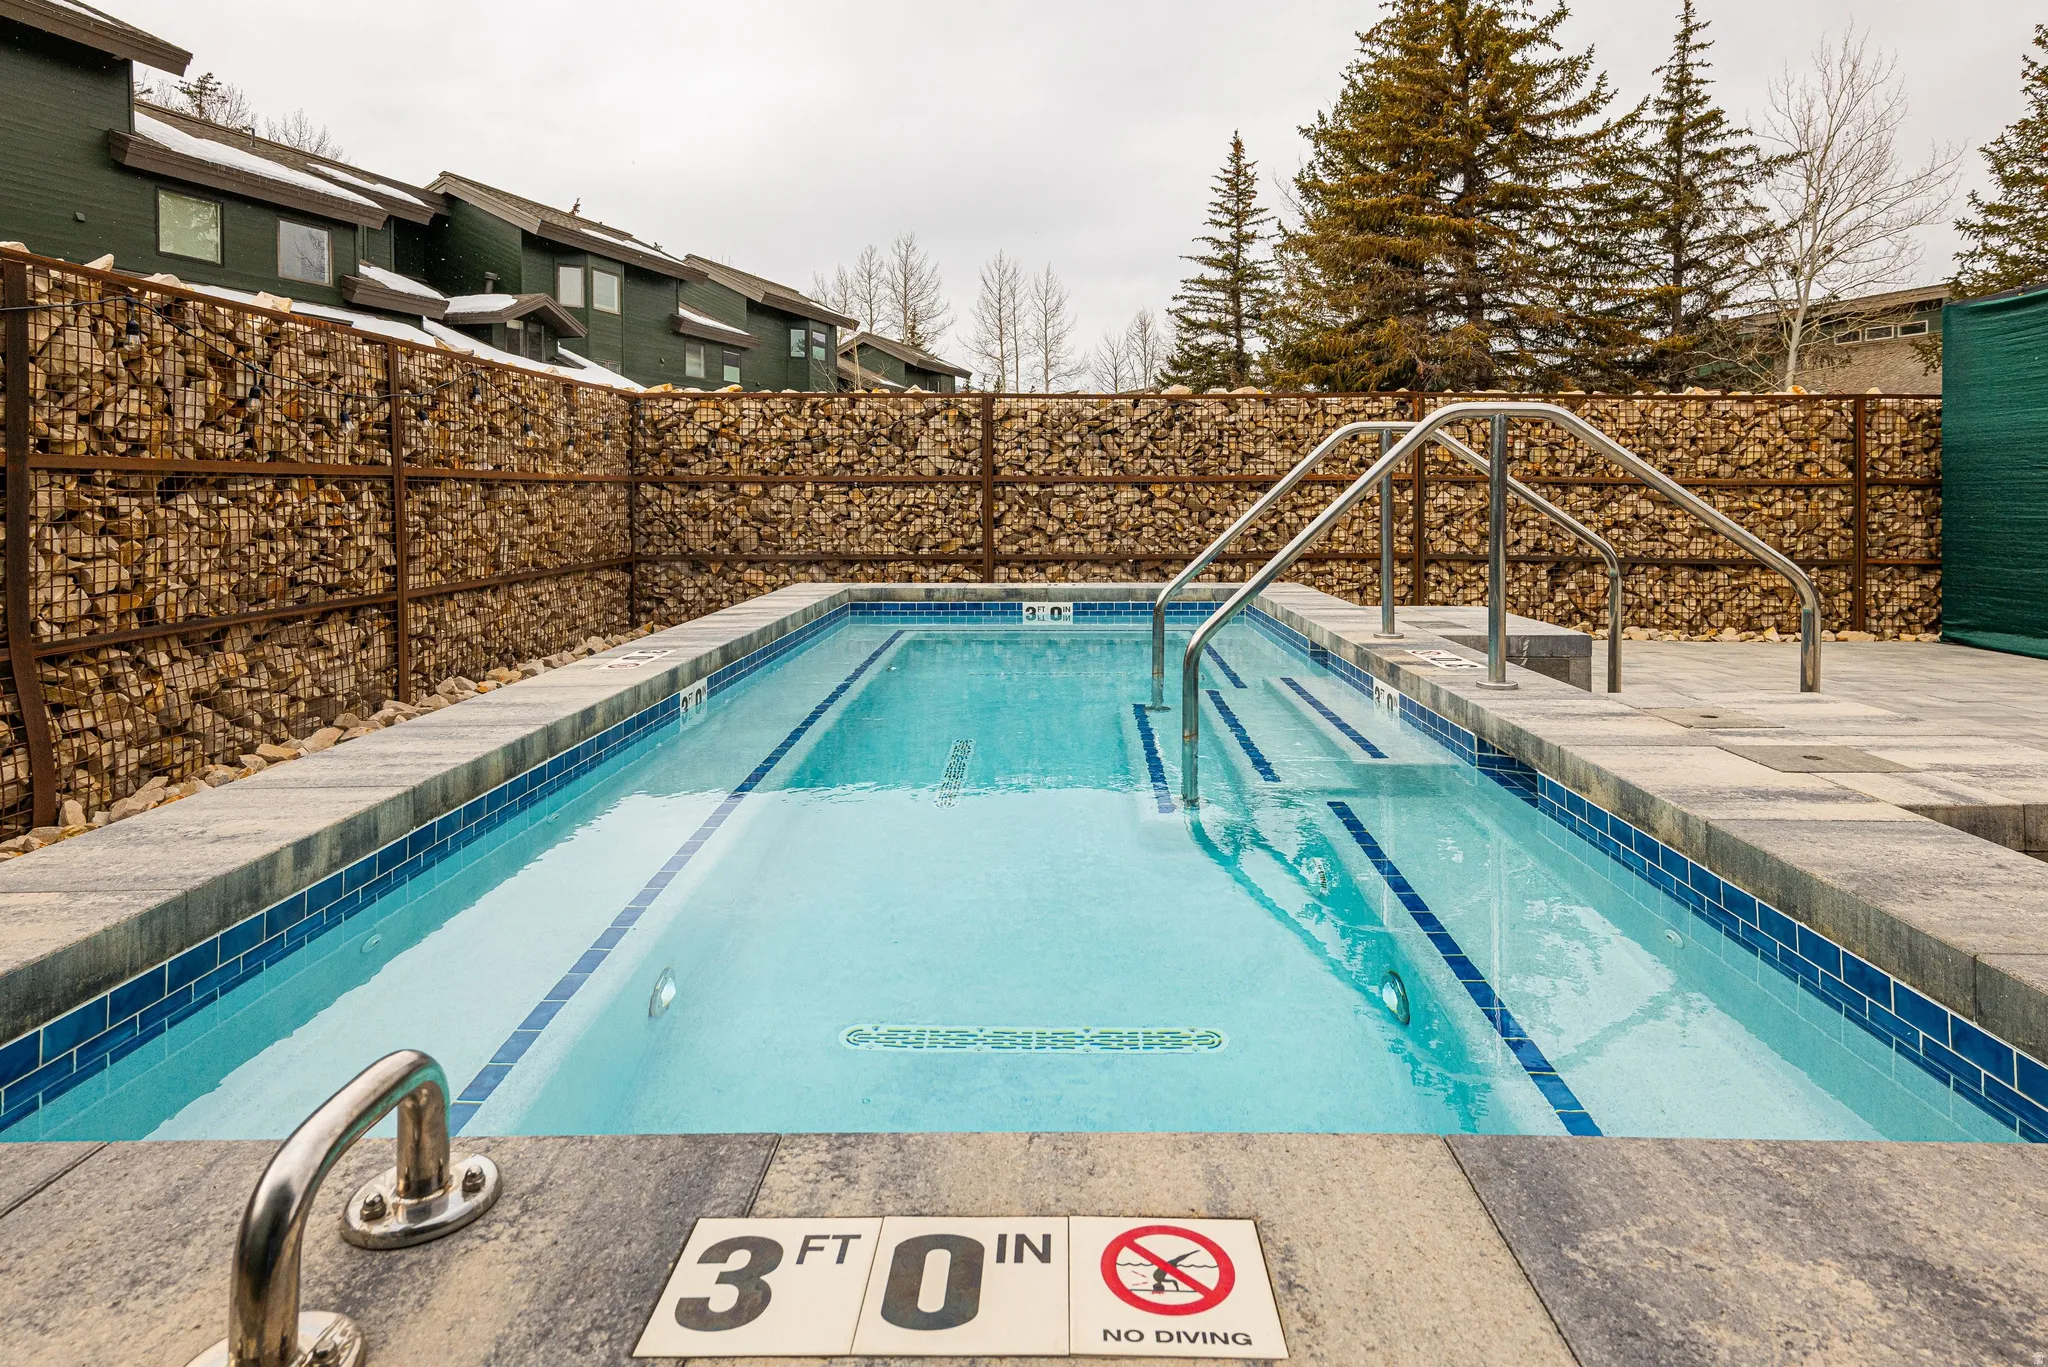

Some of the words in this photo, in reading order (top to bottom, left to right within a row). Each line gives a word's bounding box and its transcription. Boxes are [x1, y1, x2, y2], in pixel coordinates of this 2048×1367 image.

[1025, 606, 1037, 621] 3
[675, 1235, 784, 1332] 3
[795, 1234, 862, 1265] FT
[880, 1233, 985, 1331] 0
[996, 1233, 1052, 1264] IN
[1102, 1329, 1145, 1343] NO
[1154, 1330, 1253, 1346] DIVING
